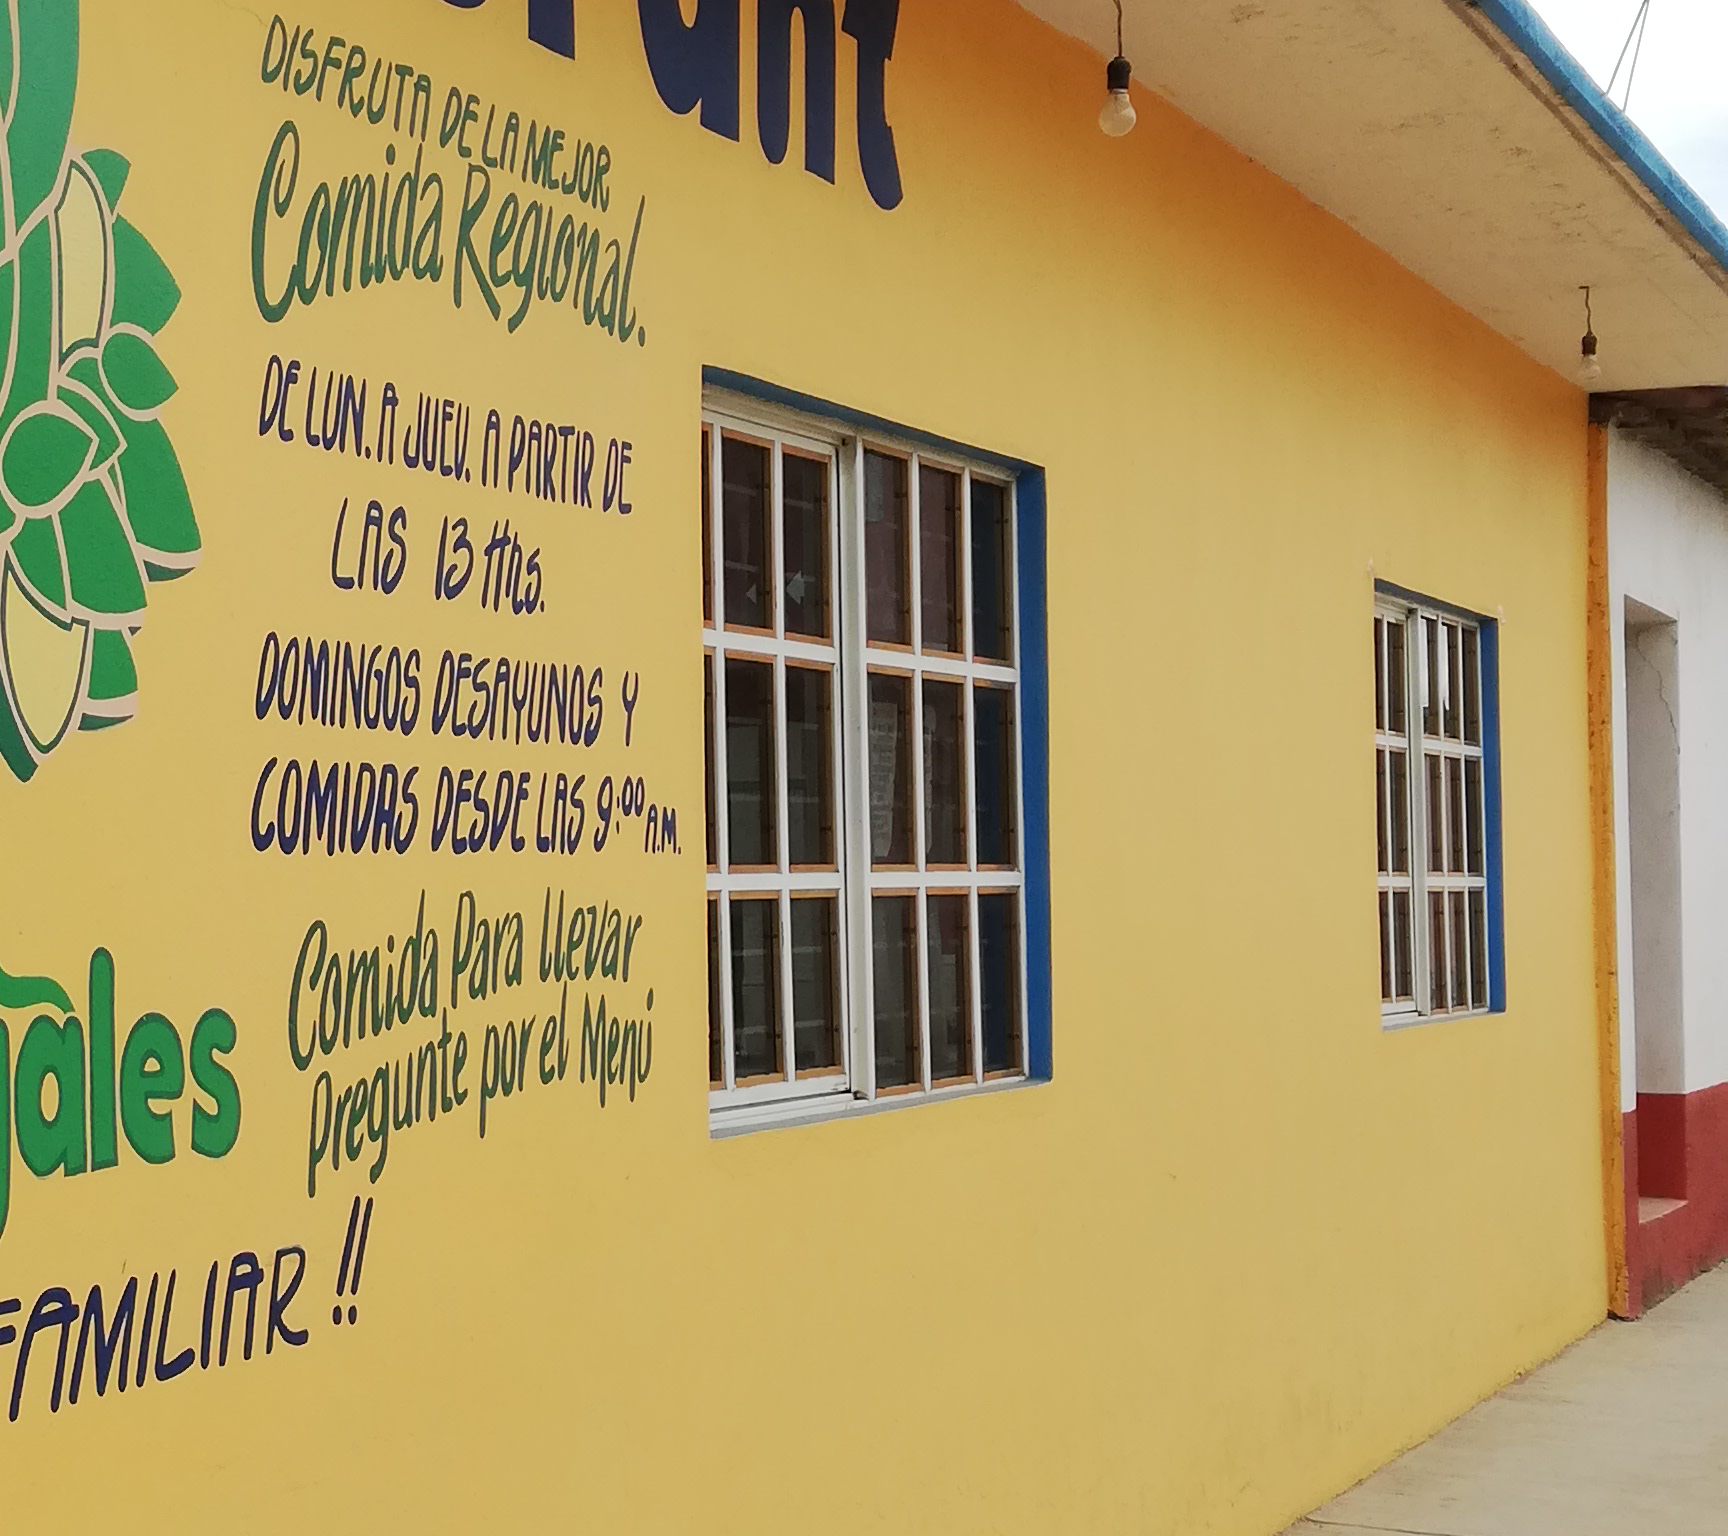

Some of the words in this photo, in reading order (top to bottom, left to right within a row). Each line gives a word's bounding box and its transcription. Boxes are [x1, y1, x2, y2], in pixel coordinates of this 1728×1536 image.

[261, 15, 431, 145] DISFRUTA
[440, 87, 480, 159] DE
[482, 104, 520, 174] LA
[522, 120, 611, 211] MEJOR
[251, 120, 444, 323] Comida
[455, 163, 647, 348] Regional.
[259, 355, 301, 442] DE
[305, 366, 372, 459] LUN.
[376, 381, 399, 464] A
[481, 409, 500, 488] A
[508, 416, 594, 509] PARTIR
[603, 438, 633, 515] DE
[331, 497, 408, 595] LAS
[435, 516, 474, 600] 13
[255, 631, 421, 737] DOMINGOS
[431, 650, 603, 747] DESAYUNOS
[622, 670, 639, 747] Y
[251, 757, 419, 856] COMIDAS
[431, 769, 529, 855] DESDE
[535, 772, 586, 855] LAS
[288, 889, 438, 1071] Comida
[451, 890, 523, 1008] Para
[480, 1015, 537, 1138] por
[541, 981, 569, 1085] el
